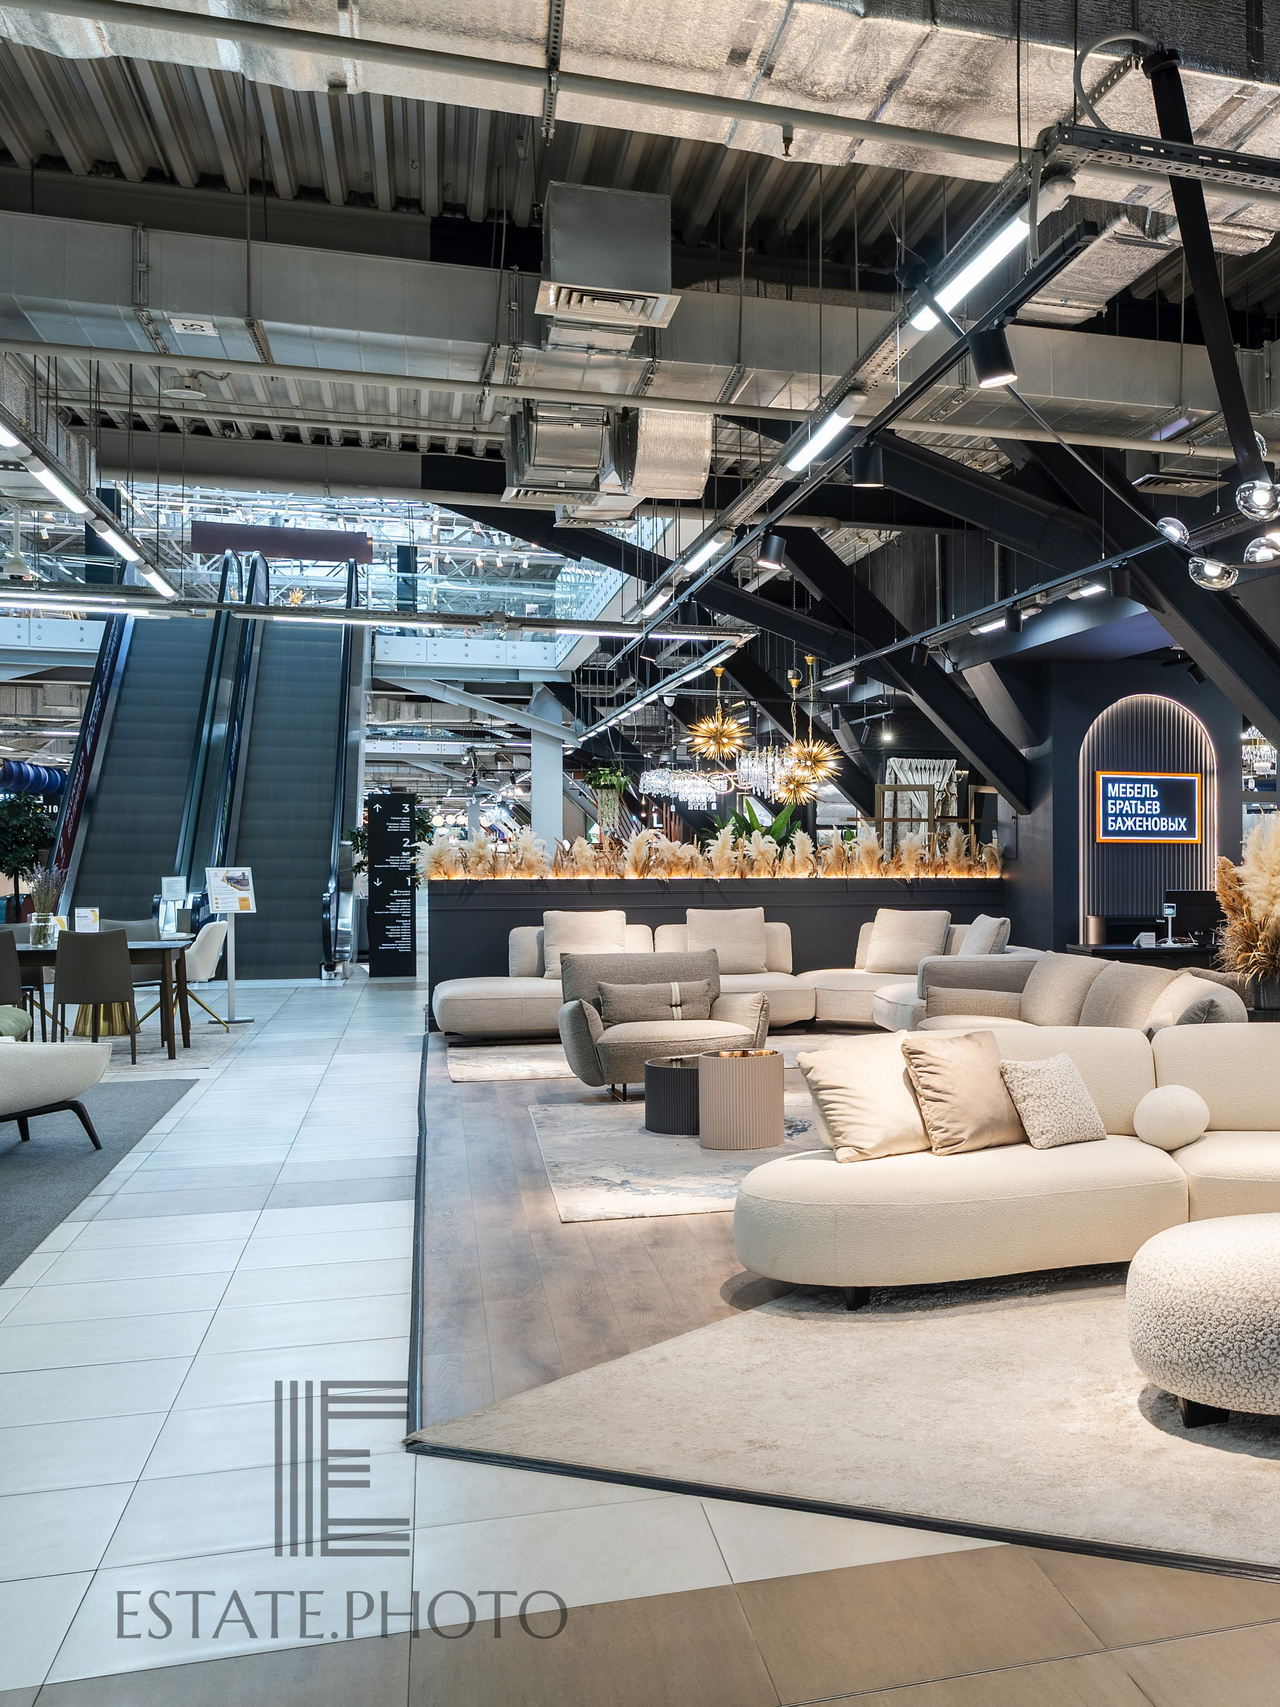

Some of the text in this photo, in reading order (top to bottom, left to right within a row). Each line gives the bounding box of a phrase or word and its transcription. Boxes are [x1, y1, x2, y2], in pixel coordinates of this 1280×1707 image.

[1107, 783, 1159, 798] МЕБЕЛЬ
[402, 803, 410, 813] 3
[1107, 799, 1161, 815] БРАТЬЕВ
[1107, 817, 1187, 832] БАЖЕНОВЫХ
[402, 838, 411, 848] 2
[406, 877, 411, 886] 1
